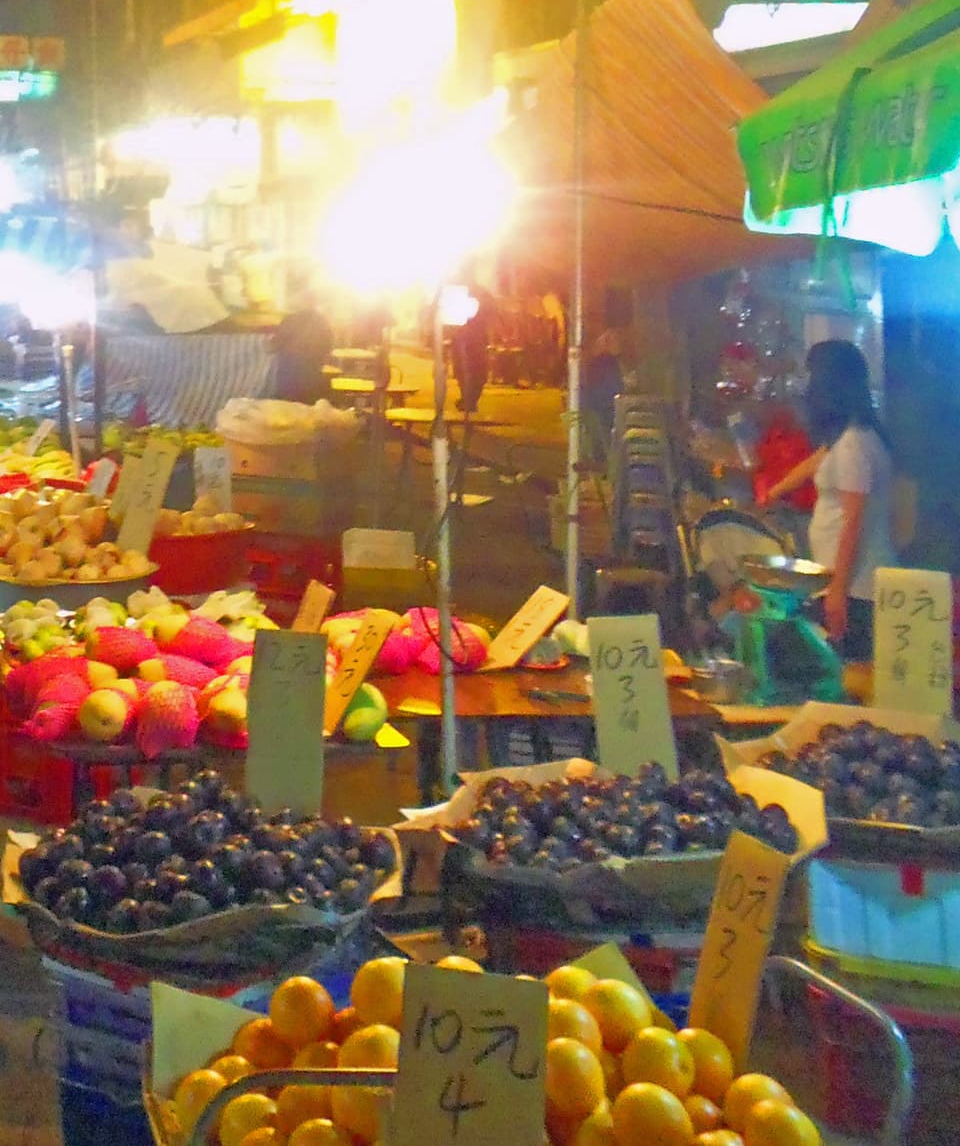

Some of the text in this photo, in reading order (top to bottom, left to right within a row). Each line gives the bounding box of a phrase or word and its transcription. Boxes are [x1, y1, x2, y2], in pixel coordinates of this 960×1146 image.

[877, 588, 949, 622] 10元
[596, 639, 659, 671] 10元
[414, 1005, 540, 1081] 10元
[439, 1073, 487, 1136] 4
